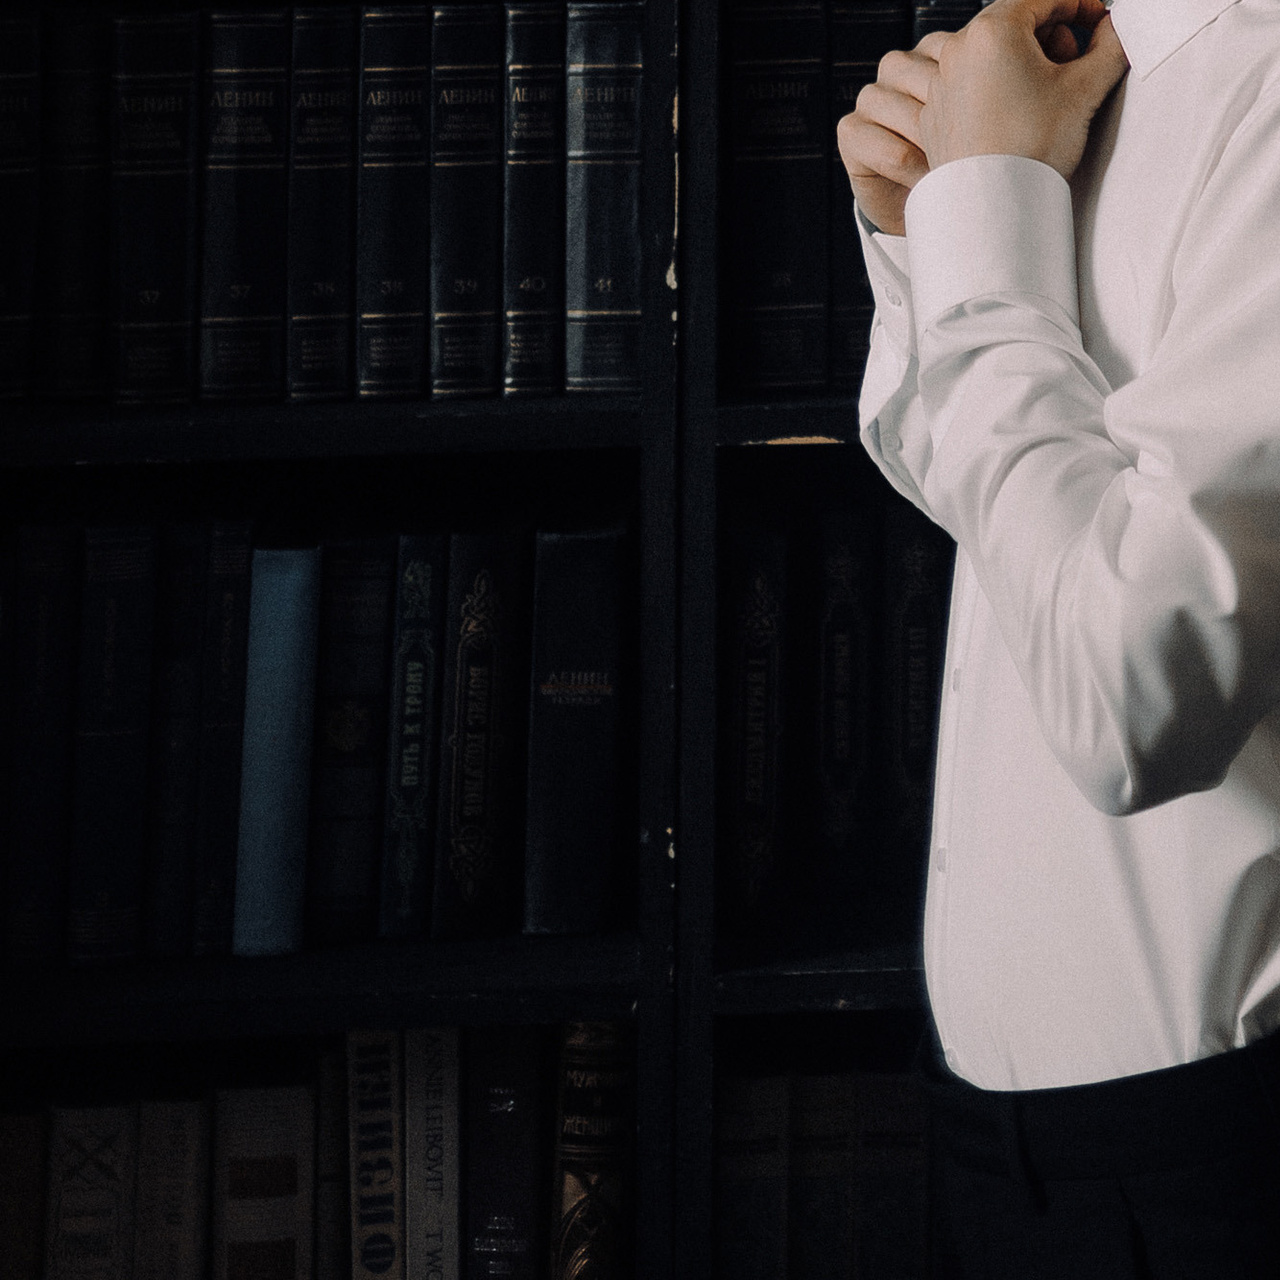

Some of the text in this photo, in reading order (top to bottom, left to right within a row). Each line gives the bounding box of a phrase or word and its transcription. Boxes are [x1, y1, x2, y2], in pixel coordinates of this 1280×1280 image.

[210, 90, 275, 108] ЛЕНИН
[365, 89, 422, 107] ЛЕНИН
[438, 88, 496, 106] ЛЕНИН
[229, 283, 252, 300] 37
[518, 275, 547, 292] 40
[593, 276, 614, 293] 41
[138, 289, 162, 306] 37
[549, 670, 611, 685] ЛЕНИН
[400, 660, 426, 788] ПУТЬ К ТРОНУ
[462, 664, 489, 818] БОРИС ГОДУНОВ
[425, 1034, 444, 1100] ANNIE
[425, 1104, 444, 1198] LEIBOVIT
